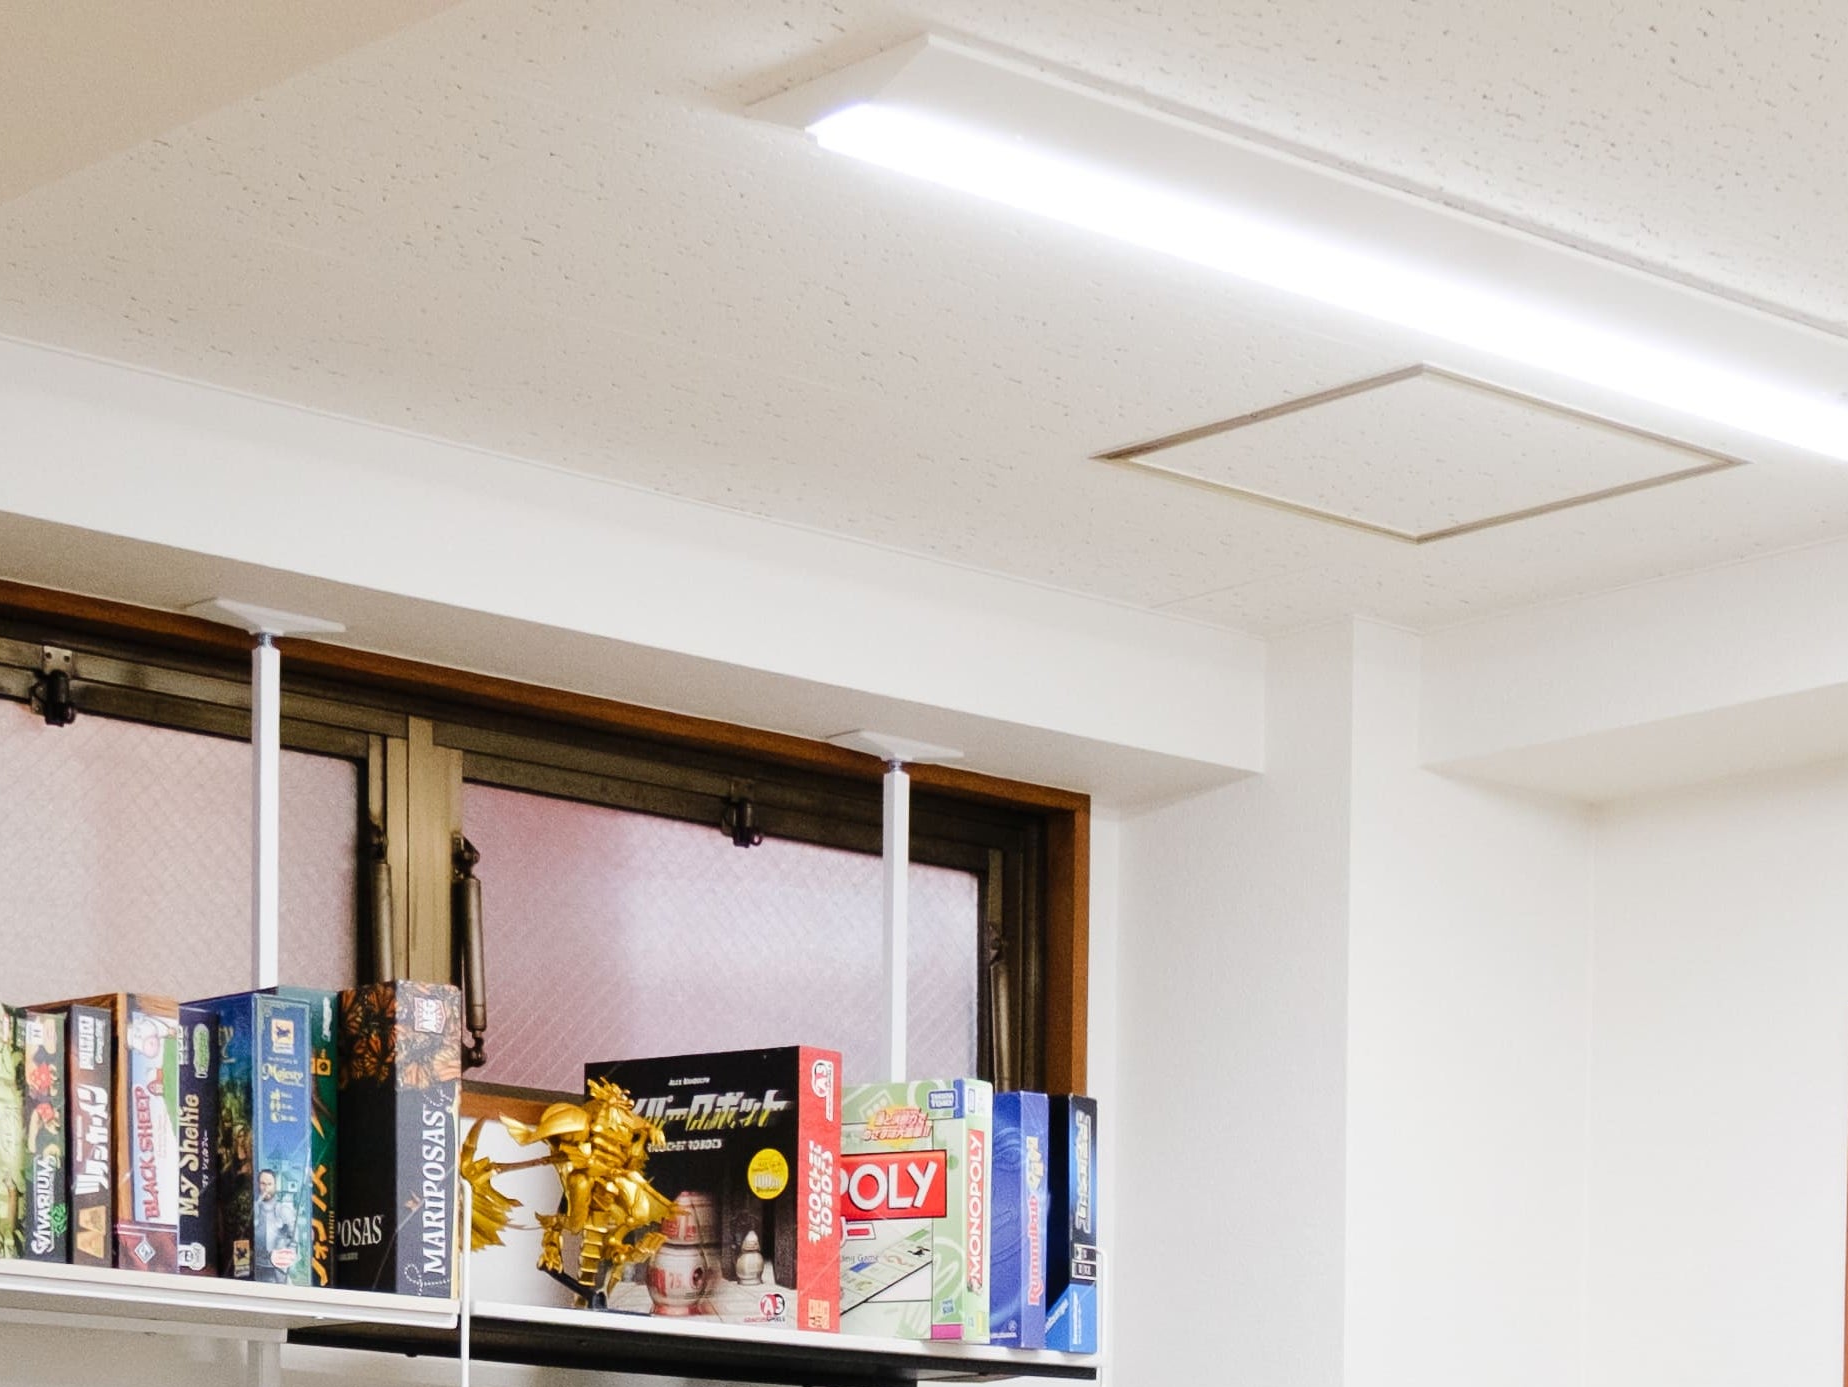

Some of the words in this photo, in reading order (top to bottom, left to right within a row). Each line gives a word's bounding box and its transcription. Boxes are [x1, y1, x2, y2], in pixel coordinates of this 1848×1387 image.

[75, 1083, 108, 1195] ツタンカーメン
[135, 1087, 154, 1145] SHEEP
[180, 1094, 199, 1170] Shelfie
[32, 1155, 60, 1254] VIVARIUM
[144, 1149, 162, 1220] BLACK
[179, 1176, 199, 1217] My
[422, 1111, 446, 1275] MARIPOSAS
[968, 1134, 984, 1286] MONOPOLY
[338, 1215, 382, 1248] OSAS
[1027, 1193, 1043, 1306] Rummikub
